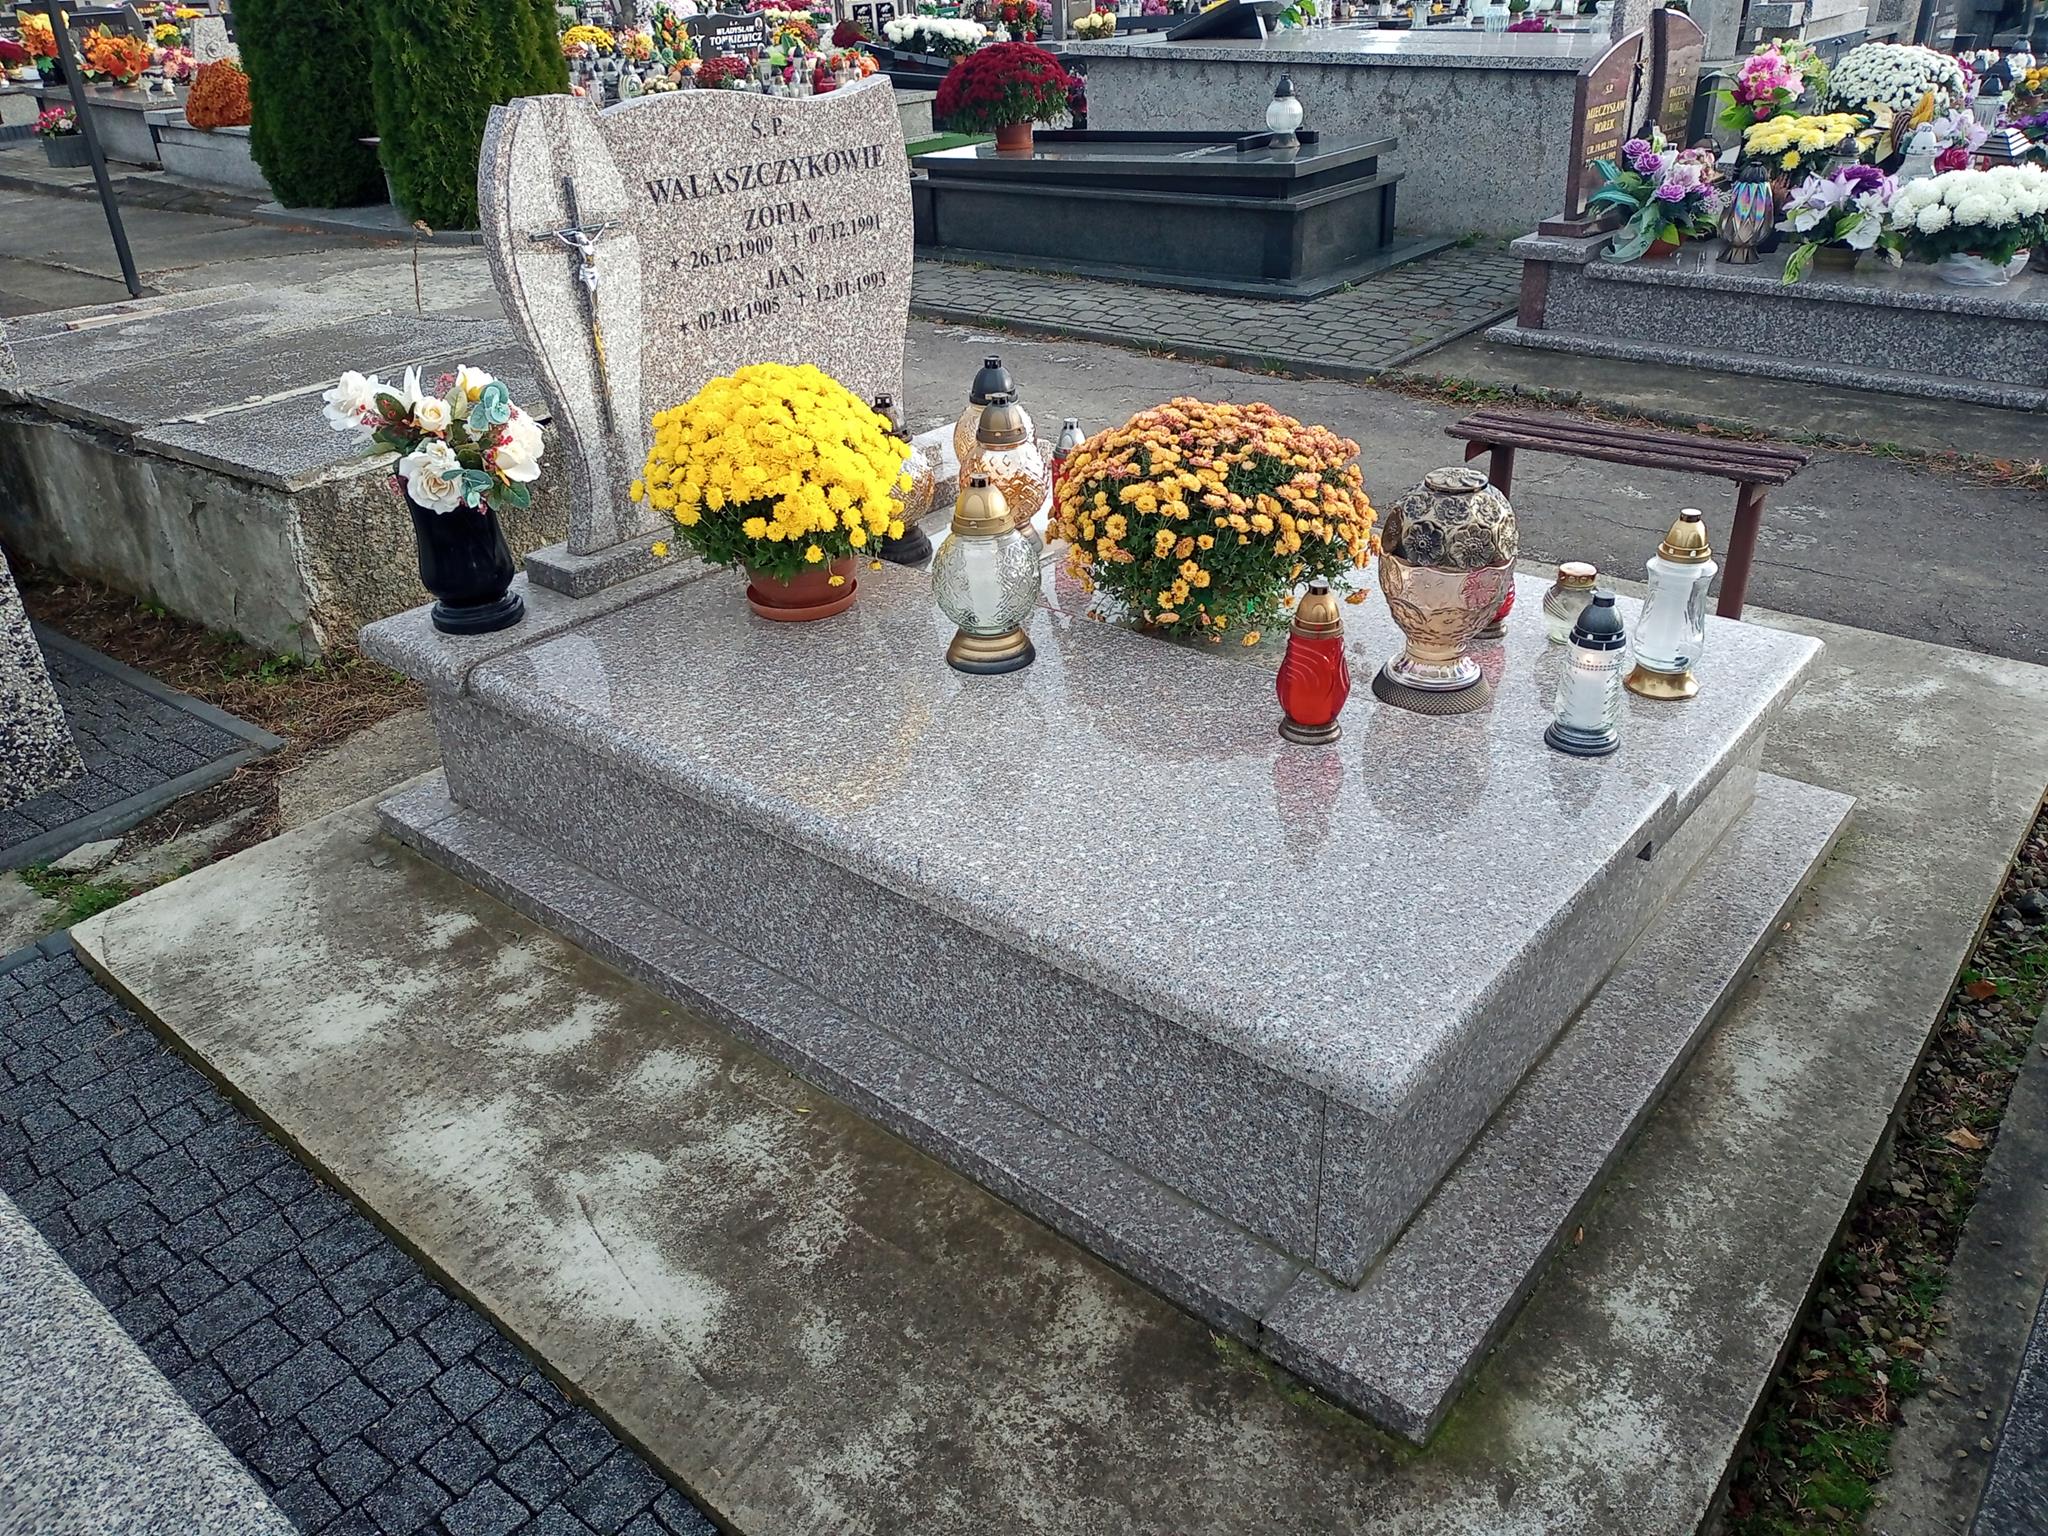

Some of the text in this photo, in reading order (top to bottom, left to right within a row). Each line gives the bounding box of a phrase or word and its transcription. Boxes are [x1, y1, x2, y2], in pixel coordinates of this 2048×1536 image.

[772, 117, 787, 137] P.
[744, 200, 812, 232] ZOFIA
[690, 214, 880, 270] 26.12.1909 07.12.1991
[766, 263, 806, 291] JAN
[699, 271, 886, 332] 02.01.1905 12.01.1993
